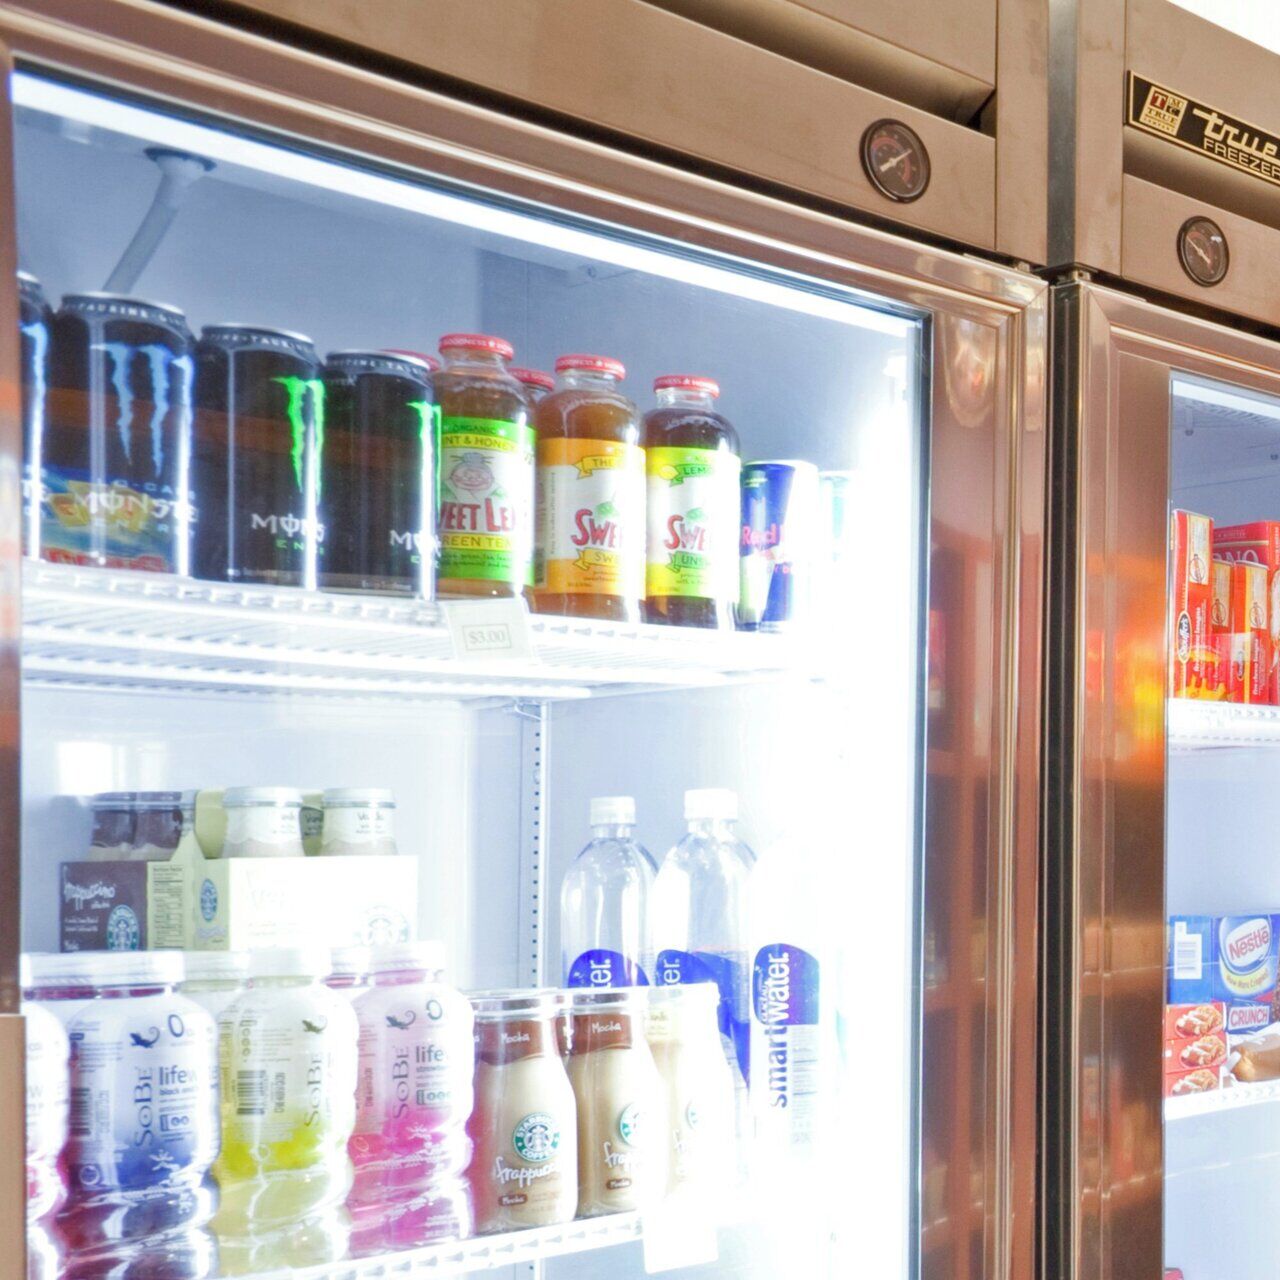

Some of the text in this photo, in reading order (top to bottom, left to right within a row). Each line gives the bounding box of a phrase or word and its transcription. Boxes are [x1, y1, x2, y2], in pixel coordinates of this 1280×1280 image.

[1146, 107, 1178, 124] TRUE
[440, 502, 481, 532] WEET
[571, 509, 618, 548] SWE
[664, 514, 706, 550] SWE
[468, 630, 505, 644] $3.00
[1230, 1007, 1268, 1027] CRUNCH
[592, 1021, 622, 1033] Mocha
[502, 1033, 531, 1043] Mocha
